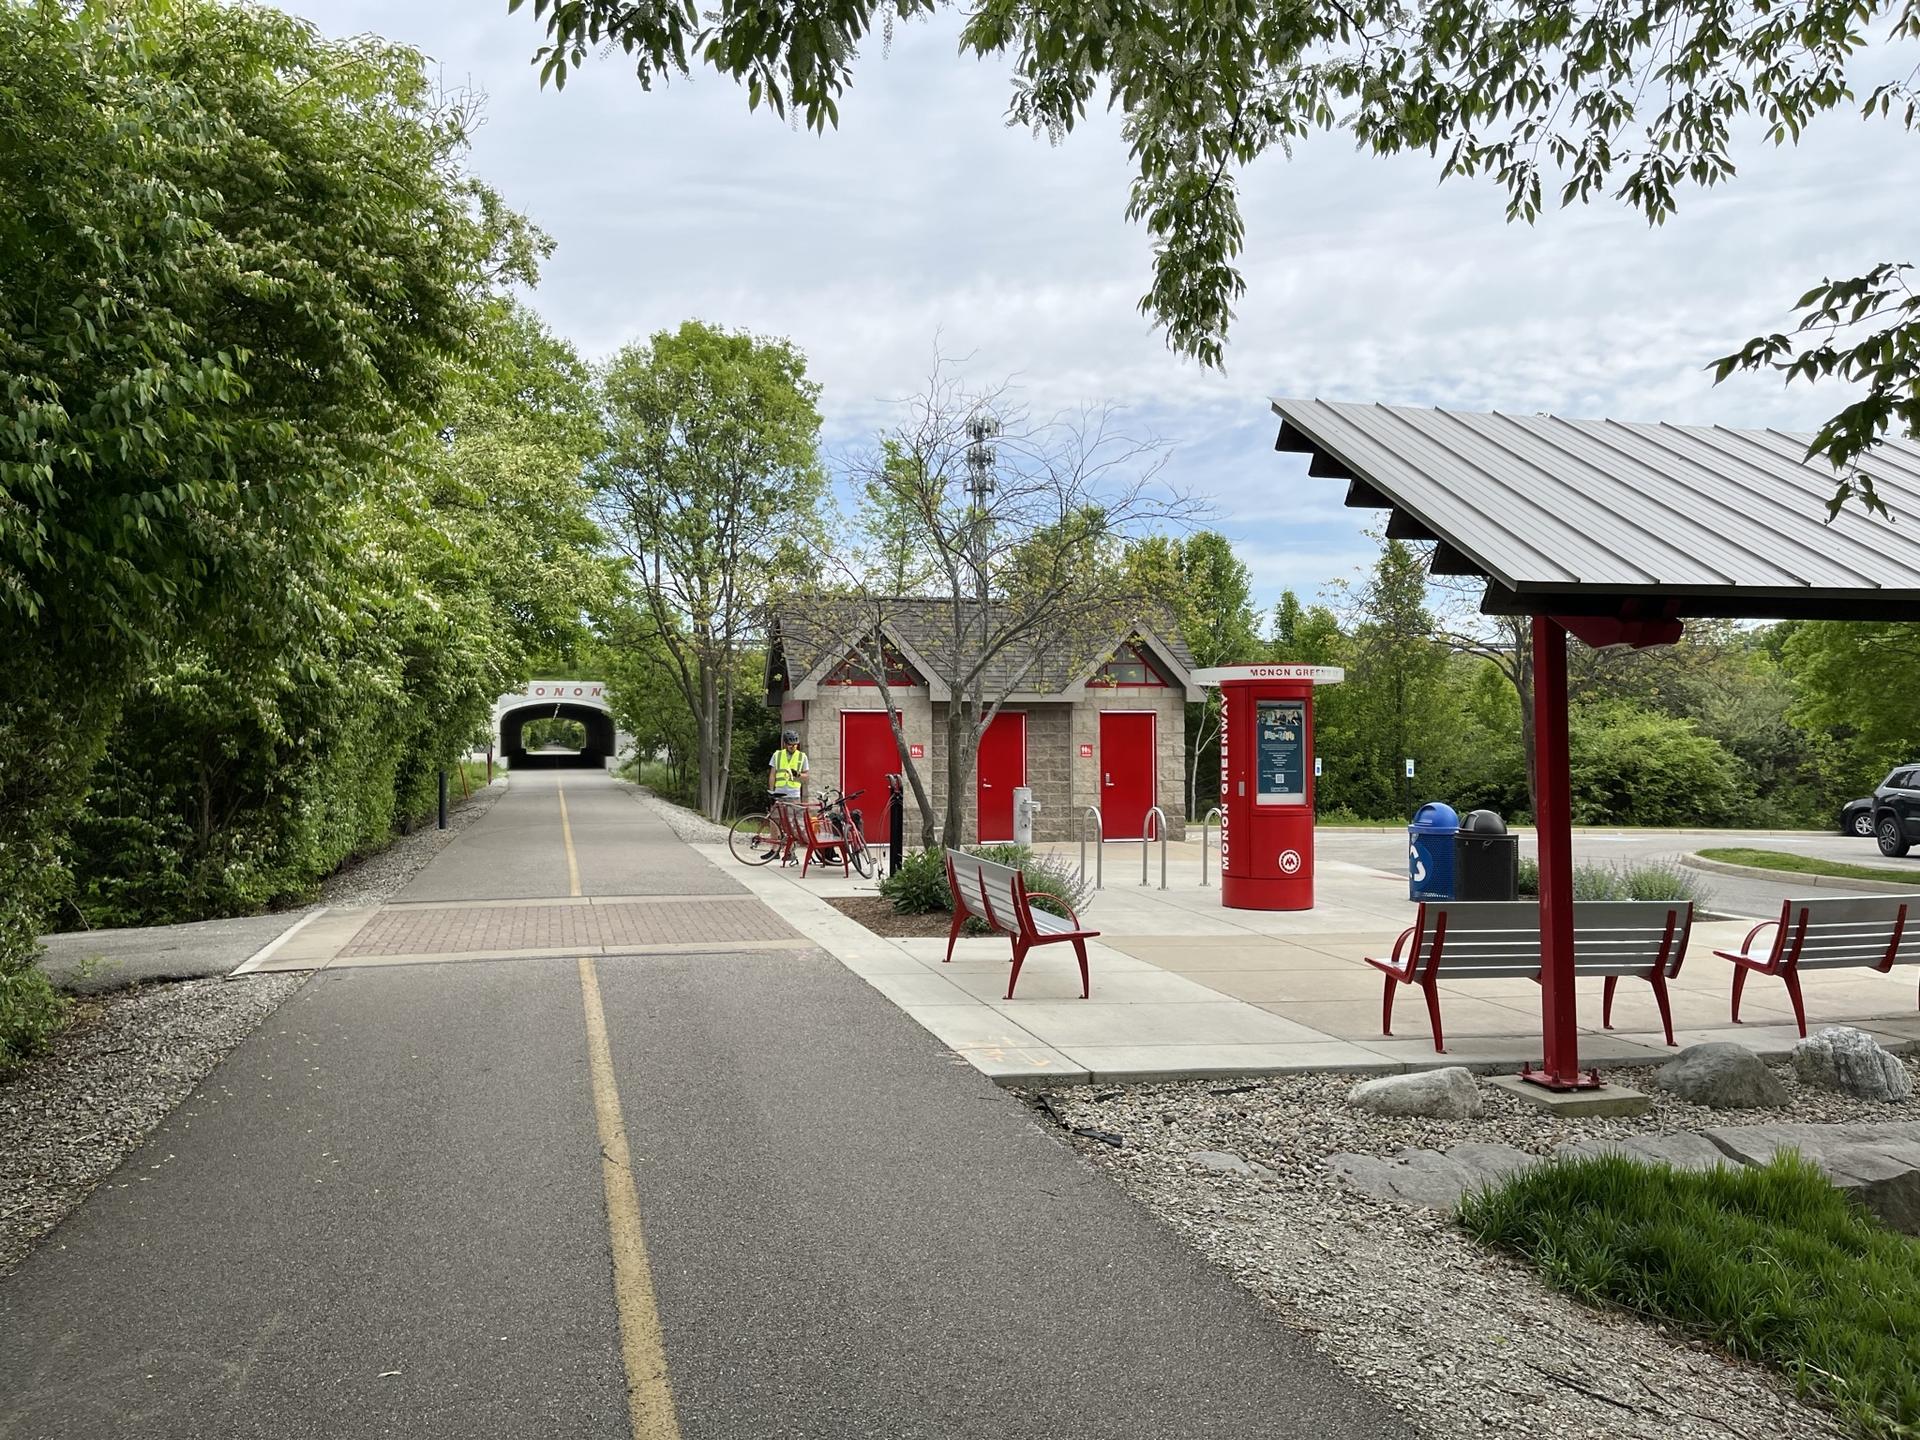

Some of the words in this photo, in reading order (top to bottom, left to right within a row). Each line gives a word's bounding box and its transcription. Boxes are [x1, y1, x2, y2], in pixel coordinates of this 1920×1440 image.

[522, 687, 602, 697] ONON
[1250, 669, 1291, 677] MONON
[1220, 693, 1229, 795] GREENWAY
[1221, 803, 1230, 870] MONON
